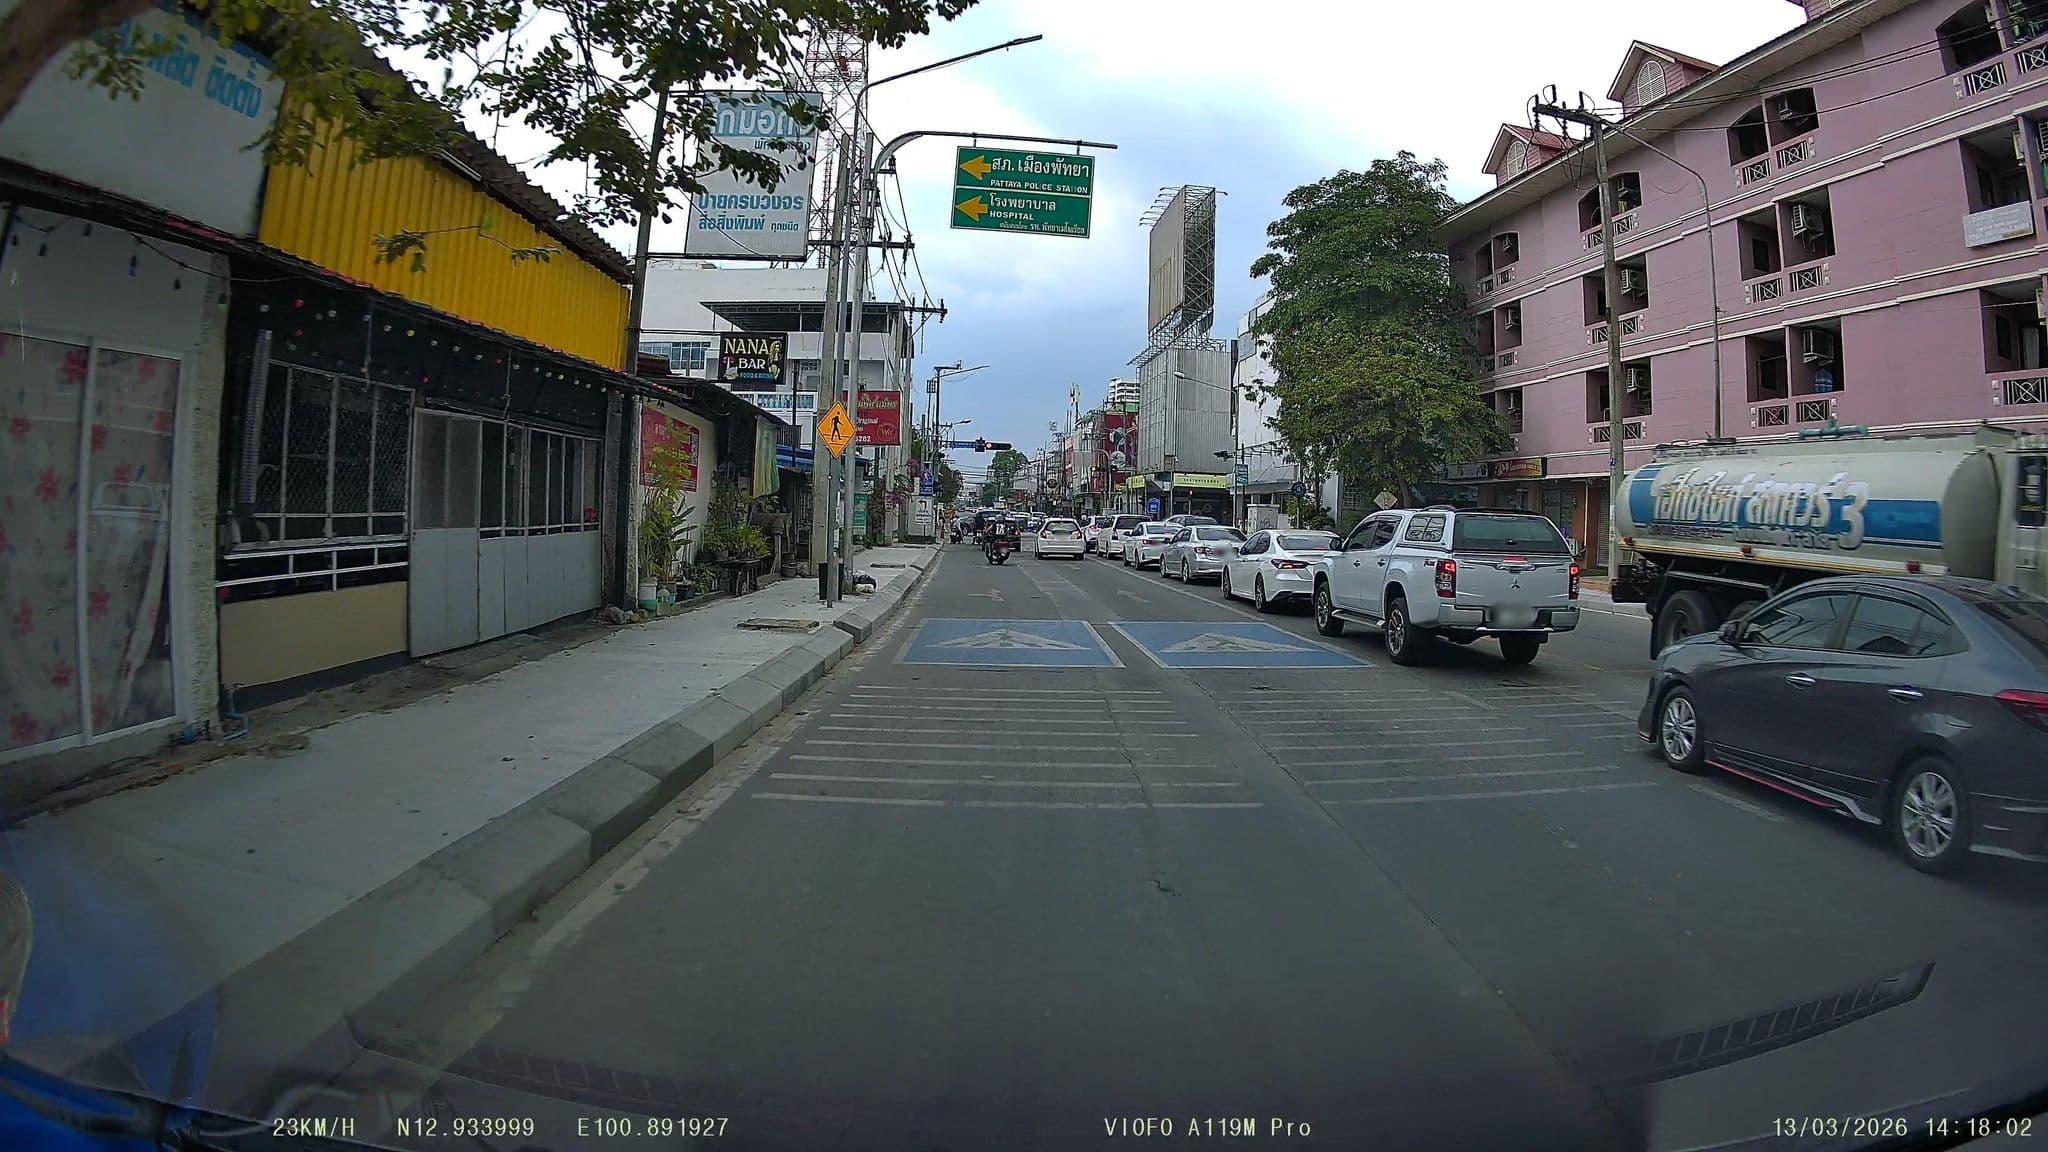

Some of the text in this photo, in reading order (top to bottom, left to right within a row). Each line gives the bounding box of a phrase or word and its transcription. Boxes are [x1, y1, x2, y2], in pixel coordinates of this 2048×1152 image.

[992, 155, 1089, 178] สภ. เมืองพัทยา
[990, 179, 1022, 189] PATTAYA
[1024, 181, 1052, 191] POLICE
[698, 191, 804, 210] ปายครบวงจร
[989, 192, 1056, 212] โรงพยาบาล
[698, 211, 799, 232] สื่อสิ่งพิมพ์ ทุกชนิด
[990, 210, 1034, 221] HOSPITAL
[724, 338, 769, 355] NANA
[739, 357, 766, 369] BAR
[1838, 481, 1871, 550] 3
